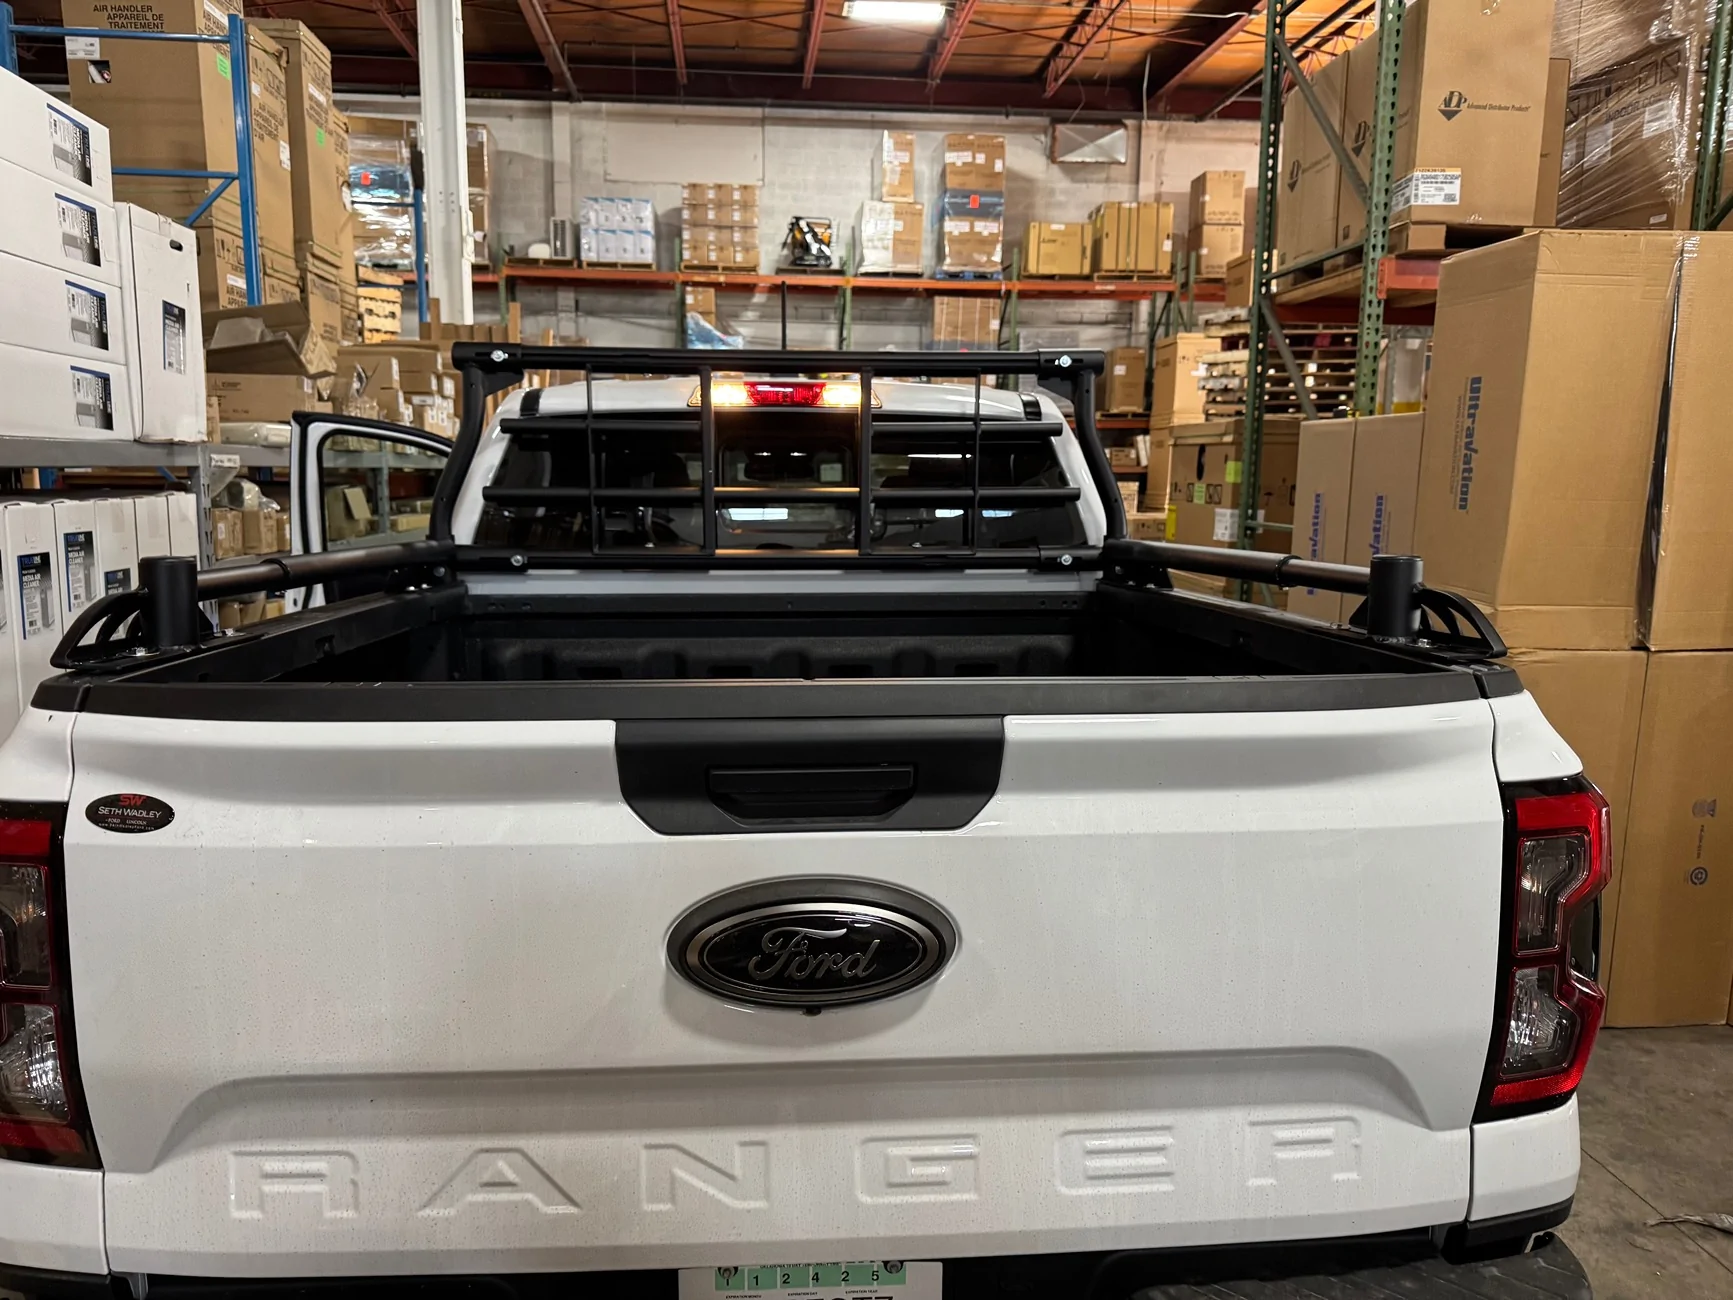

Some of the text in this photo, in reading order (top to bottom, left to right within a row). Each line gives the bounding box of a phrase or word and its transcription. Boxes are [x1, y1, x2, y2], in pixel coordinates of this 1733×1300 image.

[110, 5, 153, 13] HANDLER
[1458, 376, 1482, 510] ultravation
[69, 557, 84, 565] CLEANER
[22, 574, 34, 582] MEDIA
[23, 581, 40, 589] CLEANER
[119, 794, 146, 806] SW
[98, 806, 162, 819] SETH WADLEY
[748, 926, 881, 980] Ford
[229, 1114, 1362, 1219] RANGER
[753, 1275, 759, 1286] 1
[782, 1273, 791, 1285] 2
[811, 1272, 820, 1283] 4
[841, 1270, 850, 1281] 2
[871, 1270, 880, 1281] 5
